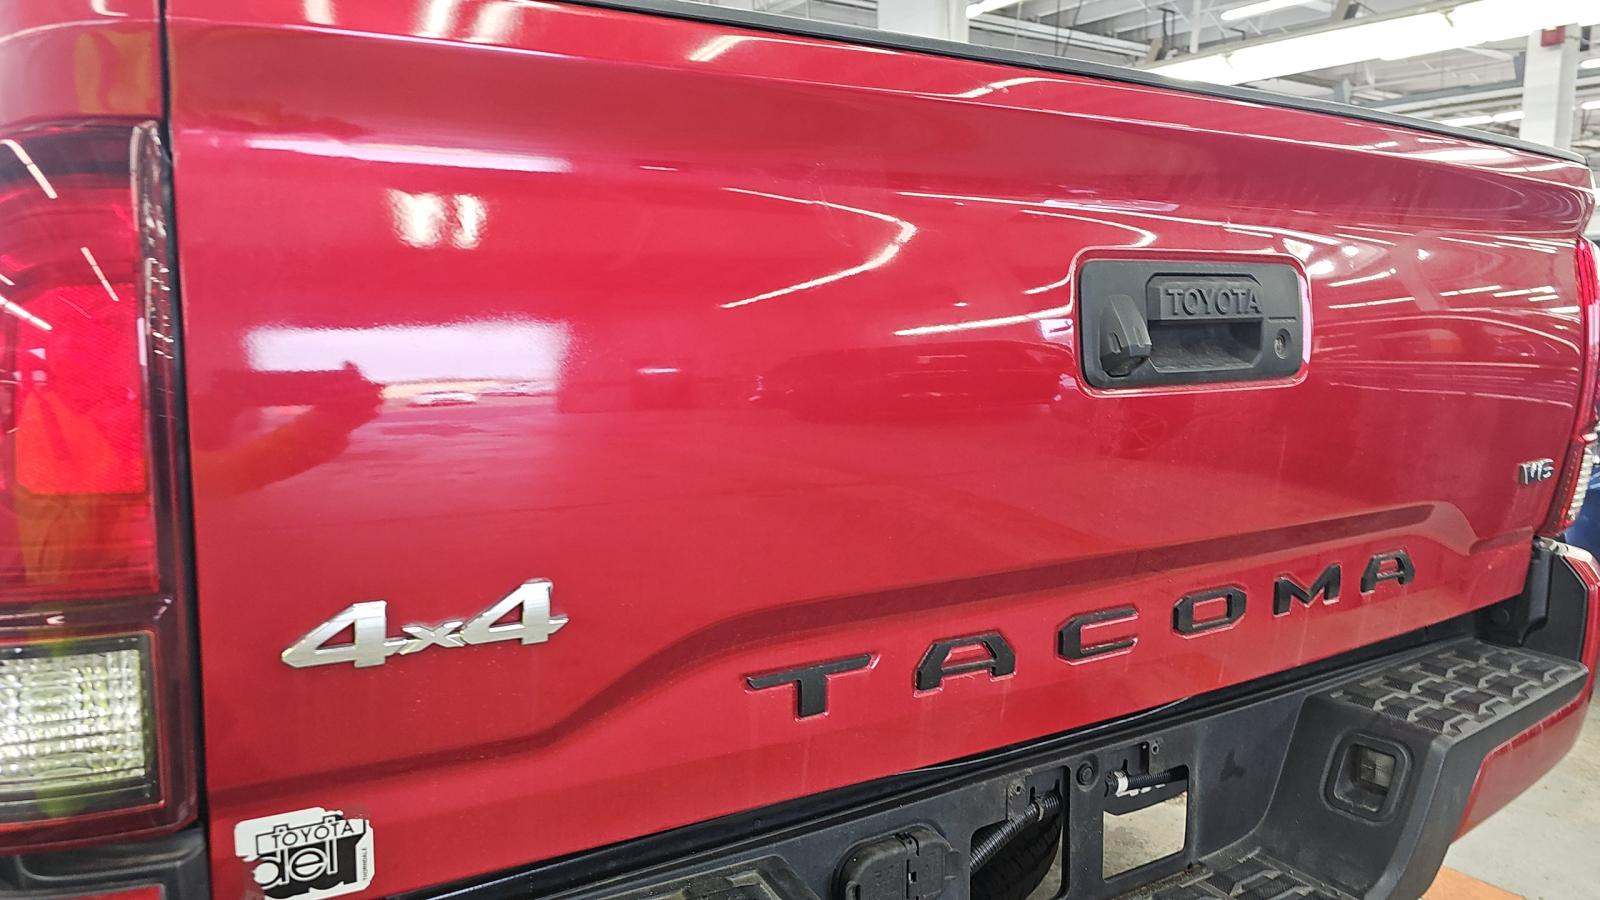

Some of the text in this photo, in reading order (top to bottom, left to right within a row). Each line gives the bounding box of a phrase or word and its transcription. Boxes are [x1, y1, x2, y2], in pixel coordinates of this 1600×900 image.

[1167, 287, 1262, 316] TOYOTA
[281, 579, 570, 669] 4x4
[745, 549, 1416, 721] TACOMA
[272, 822, 354, 849] TOYOTA
